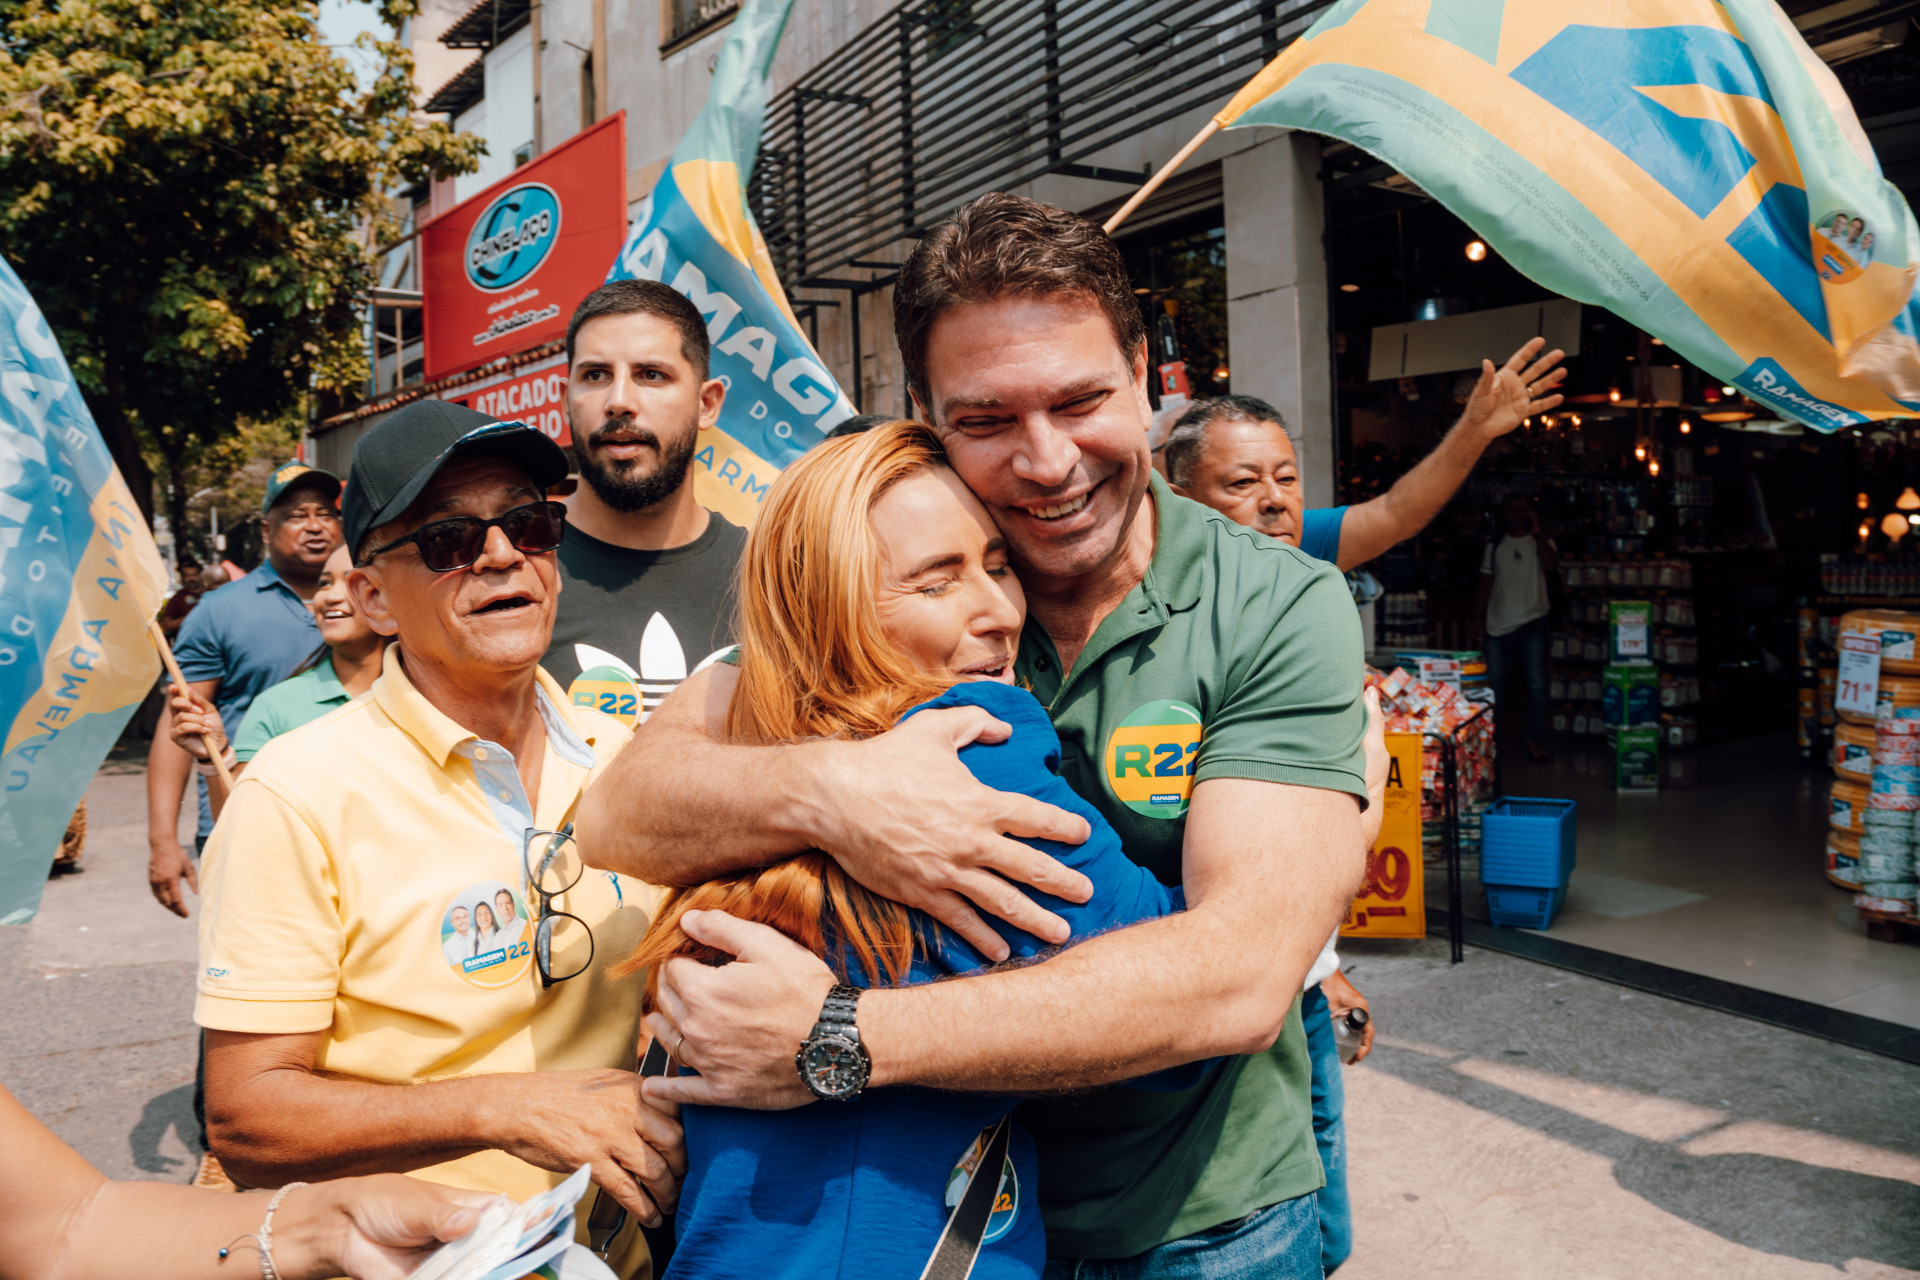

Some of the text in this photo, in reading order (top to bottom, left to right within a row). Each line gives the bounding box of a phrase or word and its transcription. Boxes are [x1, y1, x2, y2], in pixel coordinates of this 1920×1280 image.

[1547, 201, 1589, 240] CANDIDATO
[1585, 254, 1624, 292] UNIDADES
[476, 373, 561, 417] ATACADO
[1752, 367, 1858, 427] RAMAGEM
[749, 399, 792, 438] DO
[694, 445, 771, 503] ARM
[1386, 756, 1403, 788] A
[464, 950, 505, 969] RAMAGEM
[508, 941, 530, 960] 22
